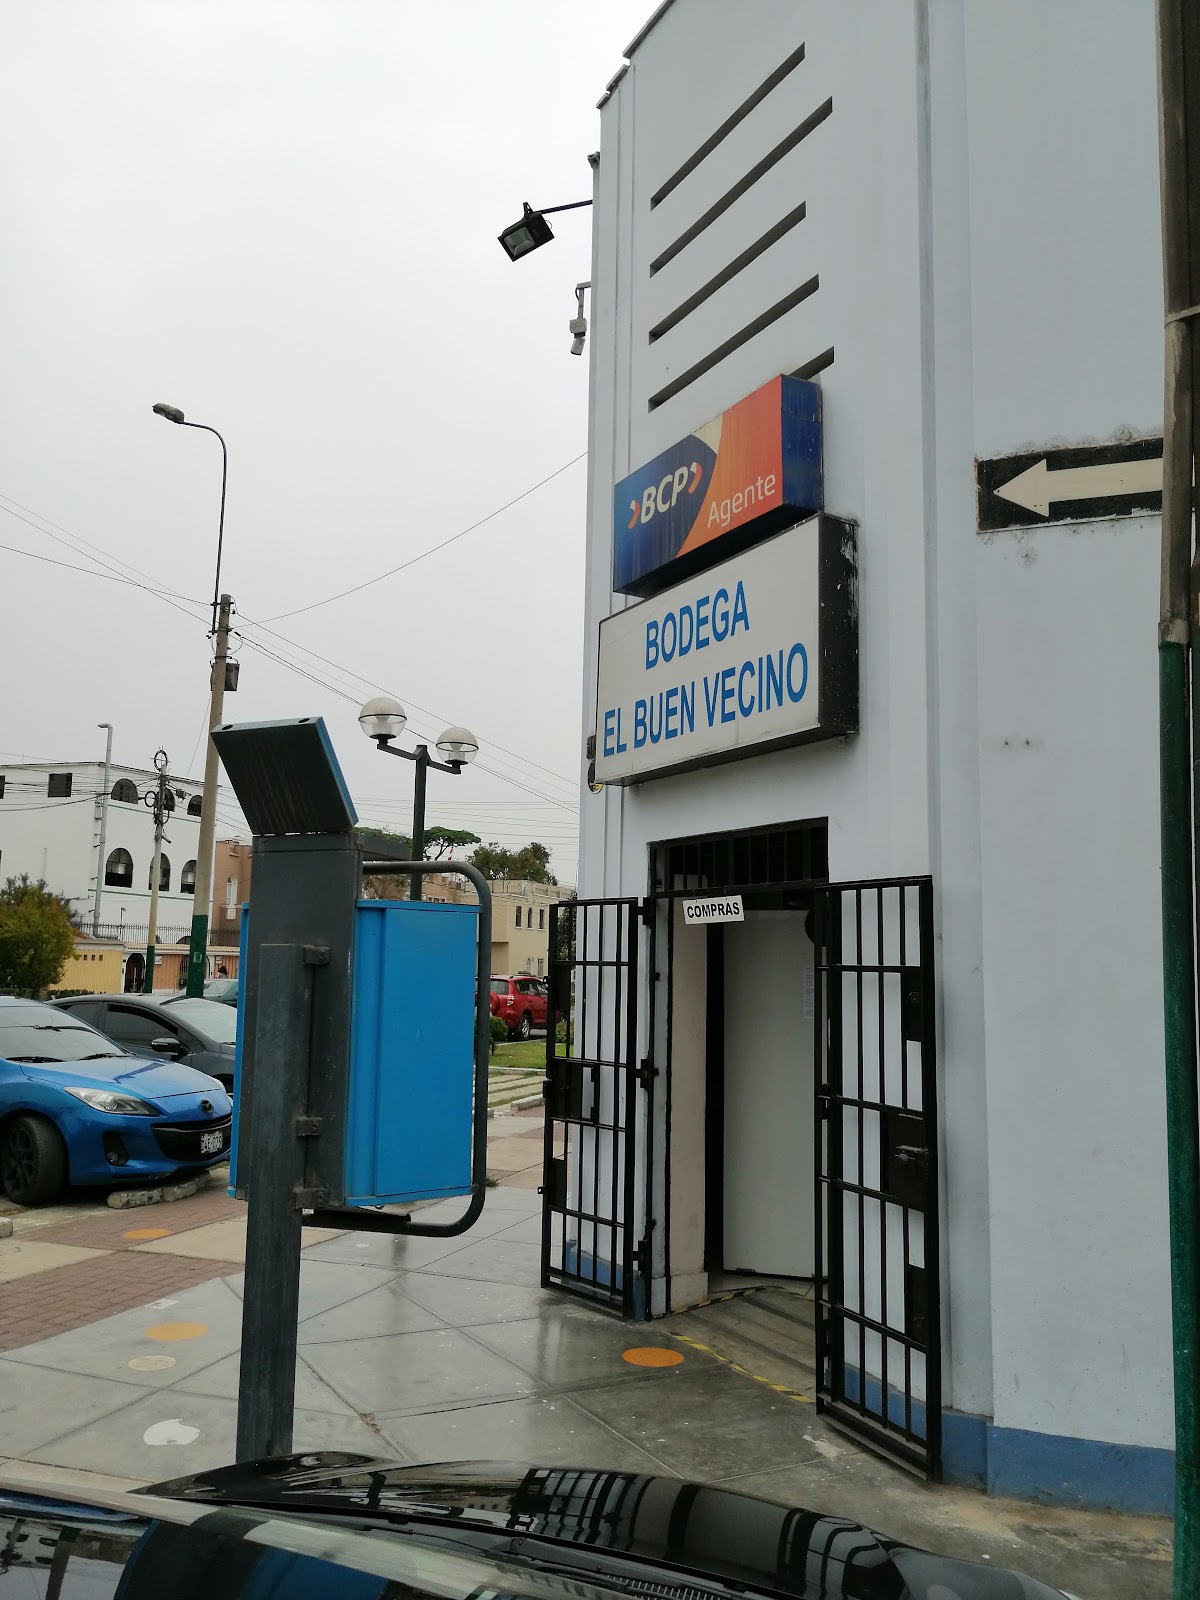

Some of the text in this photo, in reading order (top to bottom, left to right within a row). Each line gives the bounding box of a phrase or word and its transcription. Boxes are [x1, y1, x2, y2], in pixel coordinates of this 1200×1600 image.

[640, 466, 689, 524] BCP
[707, 474, 776, 529] Agente
[646, 581, 750, 670] BODEGA
[603, 642, 809, 758] EL BUEN VECINO
[687, 902, 740, 918] COMPRAS
